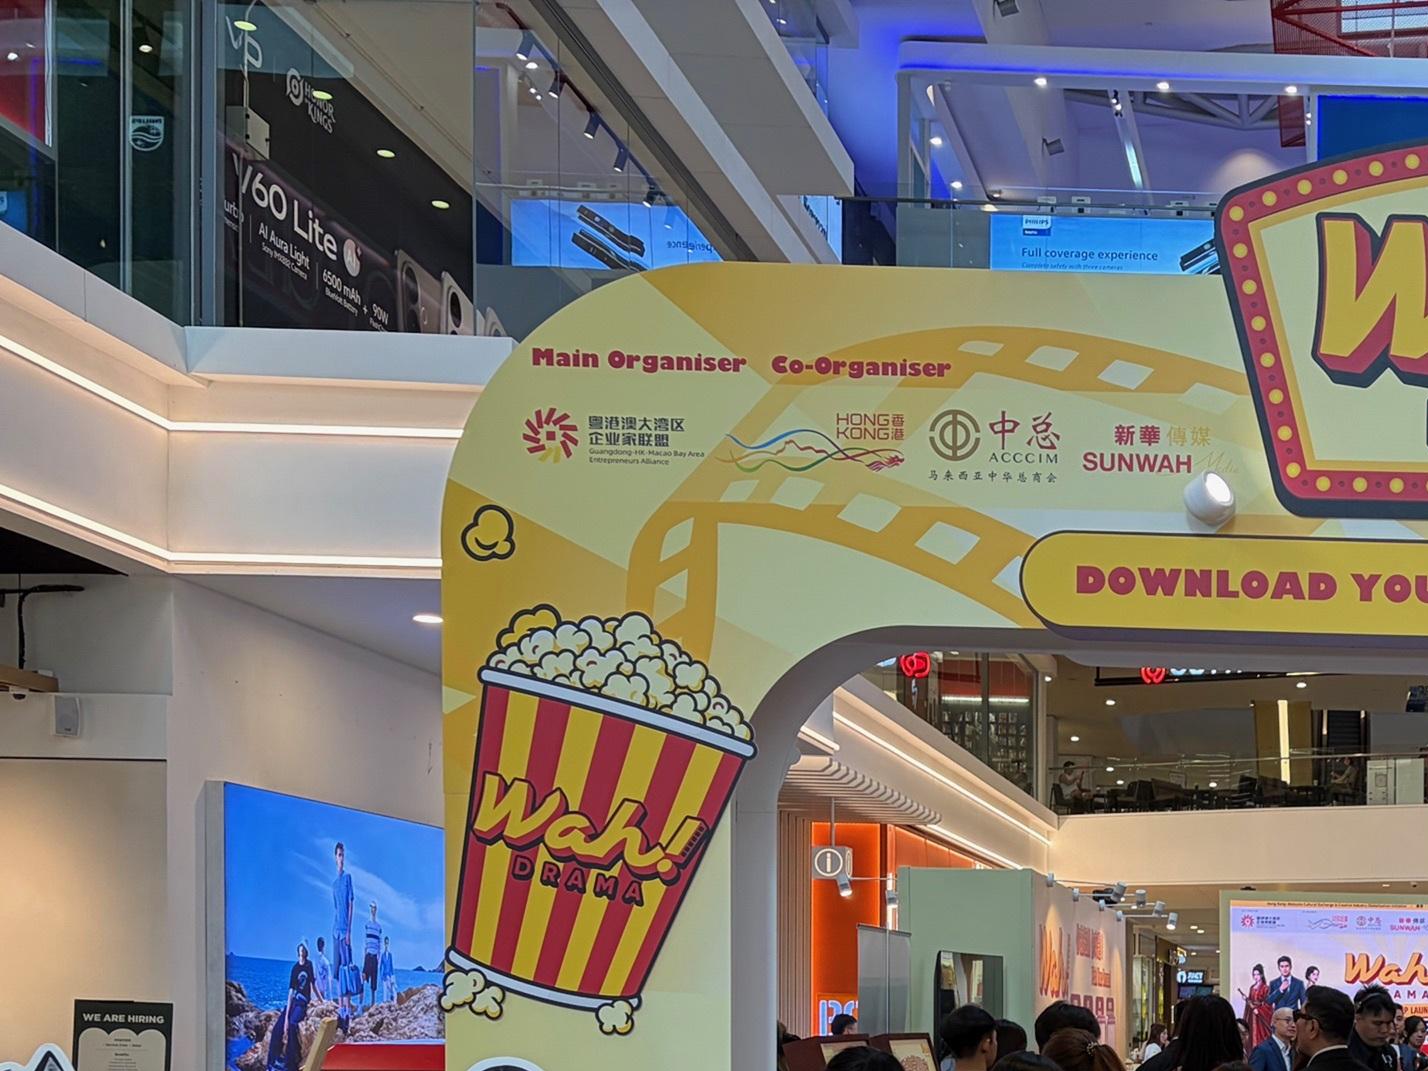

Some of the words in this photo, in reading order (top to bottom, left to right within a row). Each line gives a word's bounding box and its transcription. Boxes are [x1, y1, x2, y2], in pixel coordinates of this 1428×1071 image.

[307, 104, 334, 134] KINGS
[293, 199, 338, 262] Lite
[1024, 217, 1049, 227] PHILIPS
[270, 230, 289, 253] Aura
[289, 242, 310, 270] Light
[1021, 246, 1042, 259] Full
[1044, 249, 1095, 261] coverage
[1097, 249, 1158, 262] experience
[322, 268, 342, 292] 6500
[343, 286, 362, 305] mAh
[372, 303, 389, 325] 90W
[532, 347, 600, 368] Main
[607, 349, 747, 374] Organiser
[771, 355, 952, 379] Co-Organiser
[836, 412, 889, 427] HONG
[988, 410, 1060, 451] 中总
[588, 431, 670, 448] 企业家联盟
[836, 427, 889, 441] KONG
[1114, 424, 1211, 447] 新華傳媒
[588, 456, 639, 465] Entrepreneurs
[641, 458, 670, 466] Alliance
[673, 450, 686, 459] Bay
[988, 452, 1059, 465] ACCCIM
[1082, 451, 1192, 474] SUNWAH
[1075, 564, 1337, 601] DOWNLOAD
[471, 770, 714, 886] Wah!
[511, 854, 644, 907] DRAMA
[82, 1013, 101, 1022] WE
[102, 1013, 126, 1023] ARE
[127, 1014, 165, 1024] HIRING
